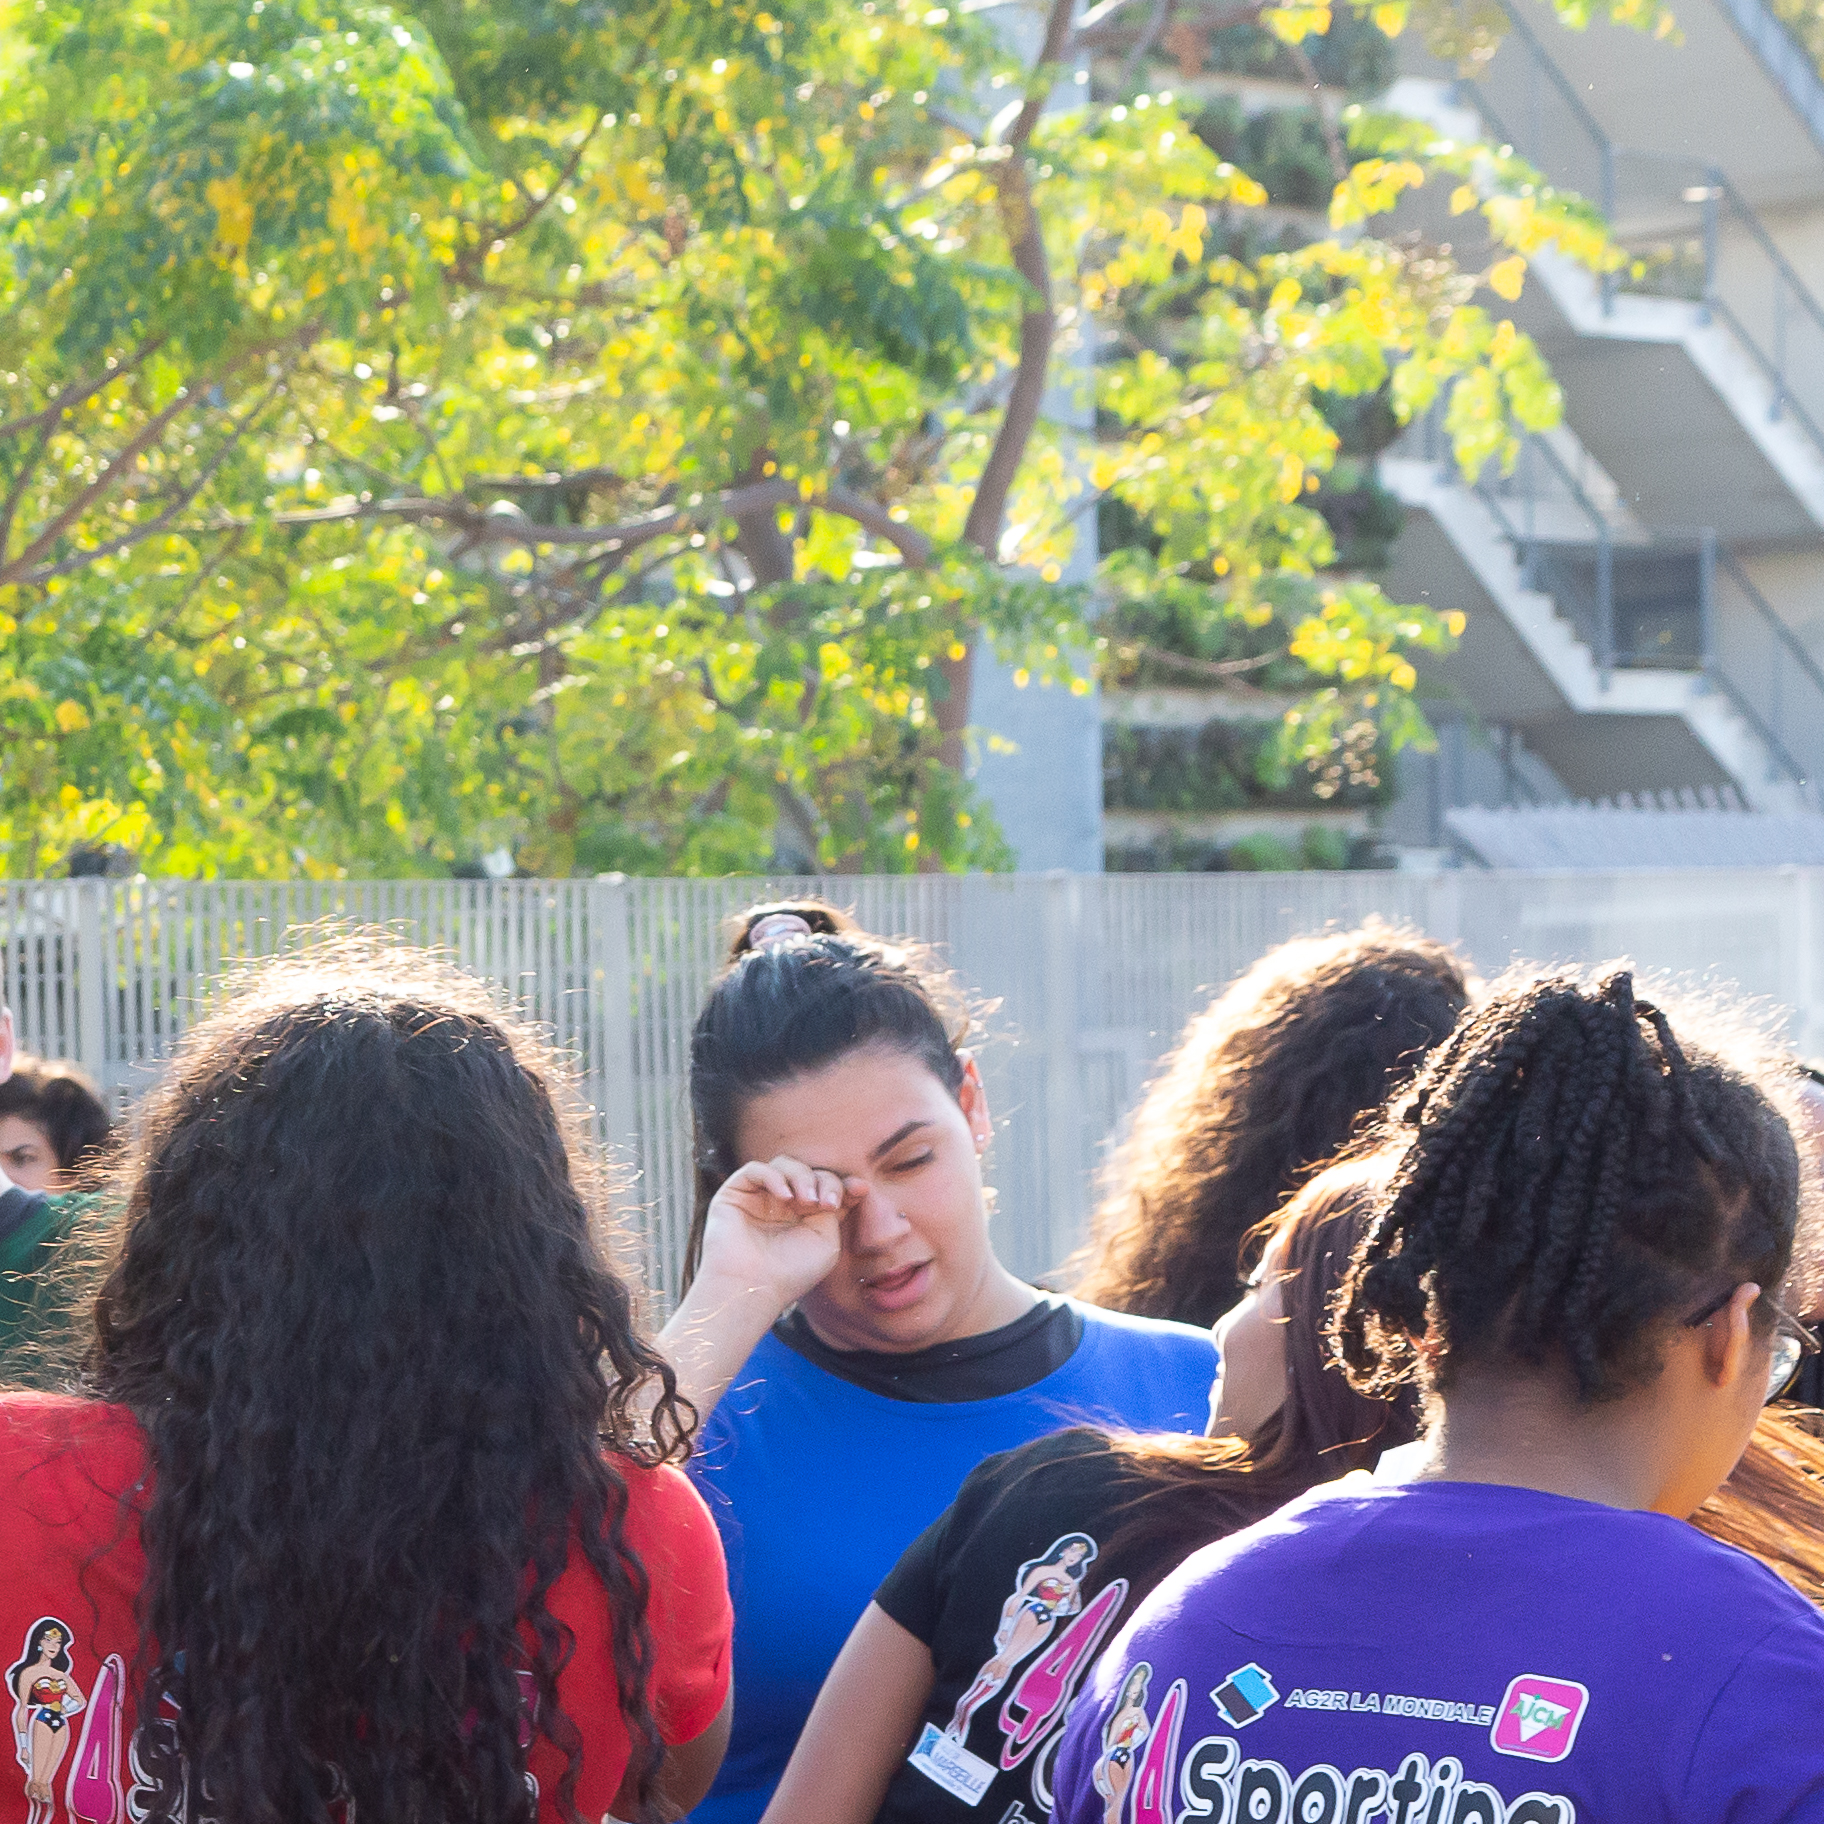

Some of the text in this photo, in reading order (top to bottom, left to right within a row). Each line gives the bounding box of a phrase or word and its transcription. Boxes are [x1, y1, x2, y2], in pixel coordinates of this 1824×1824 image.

[1283, 1688, 1496, 1726] AG2R LA MONDIALE
